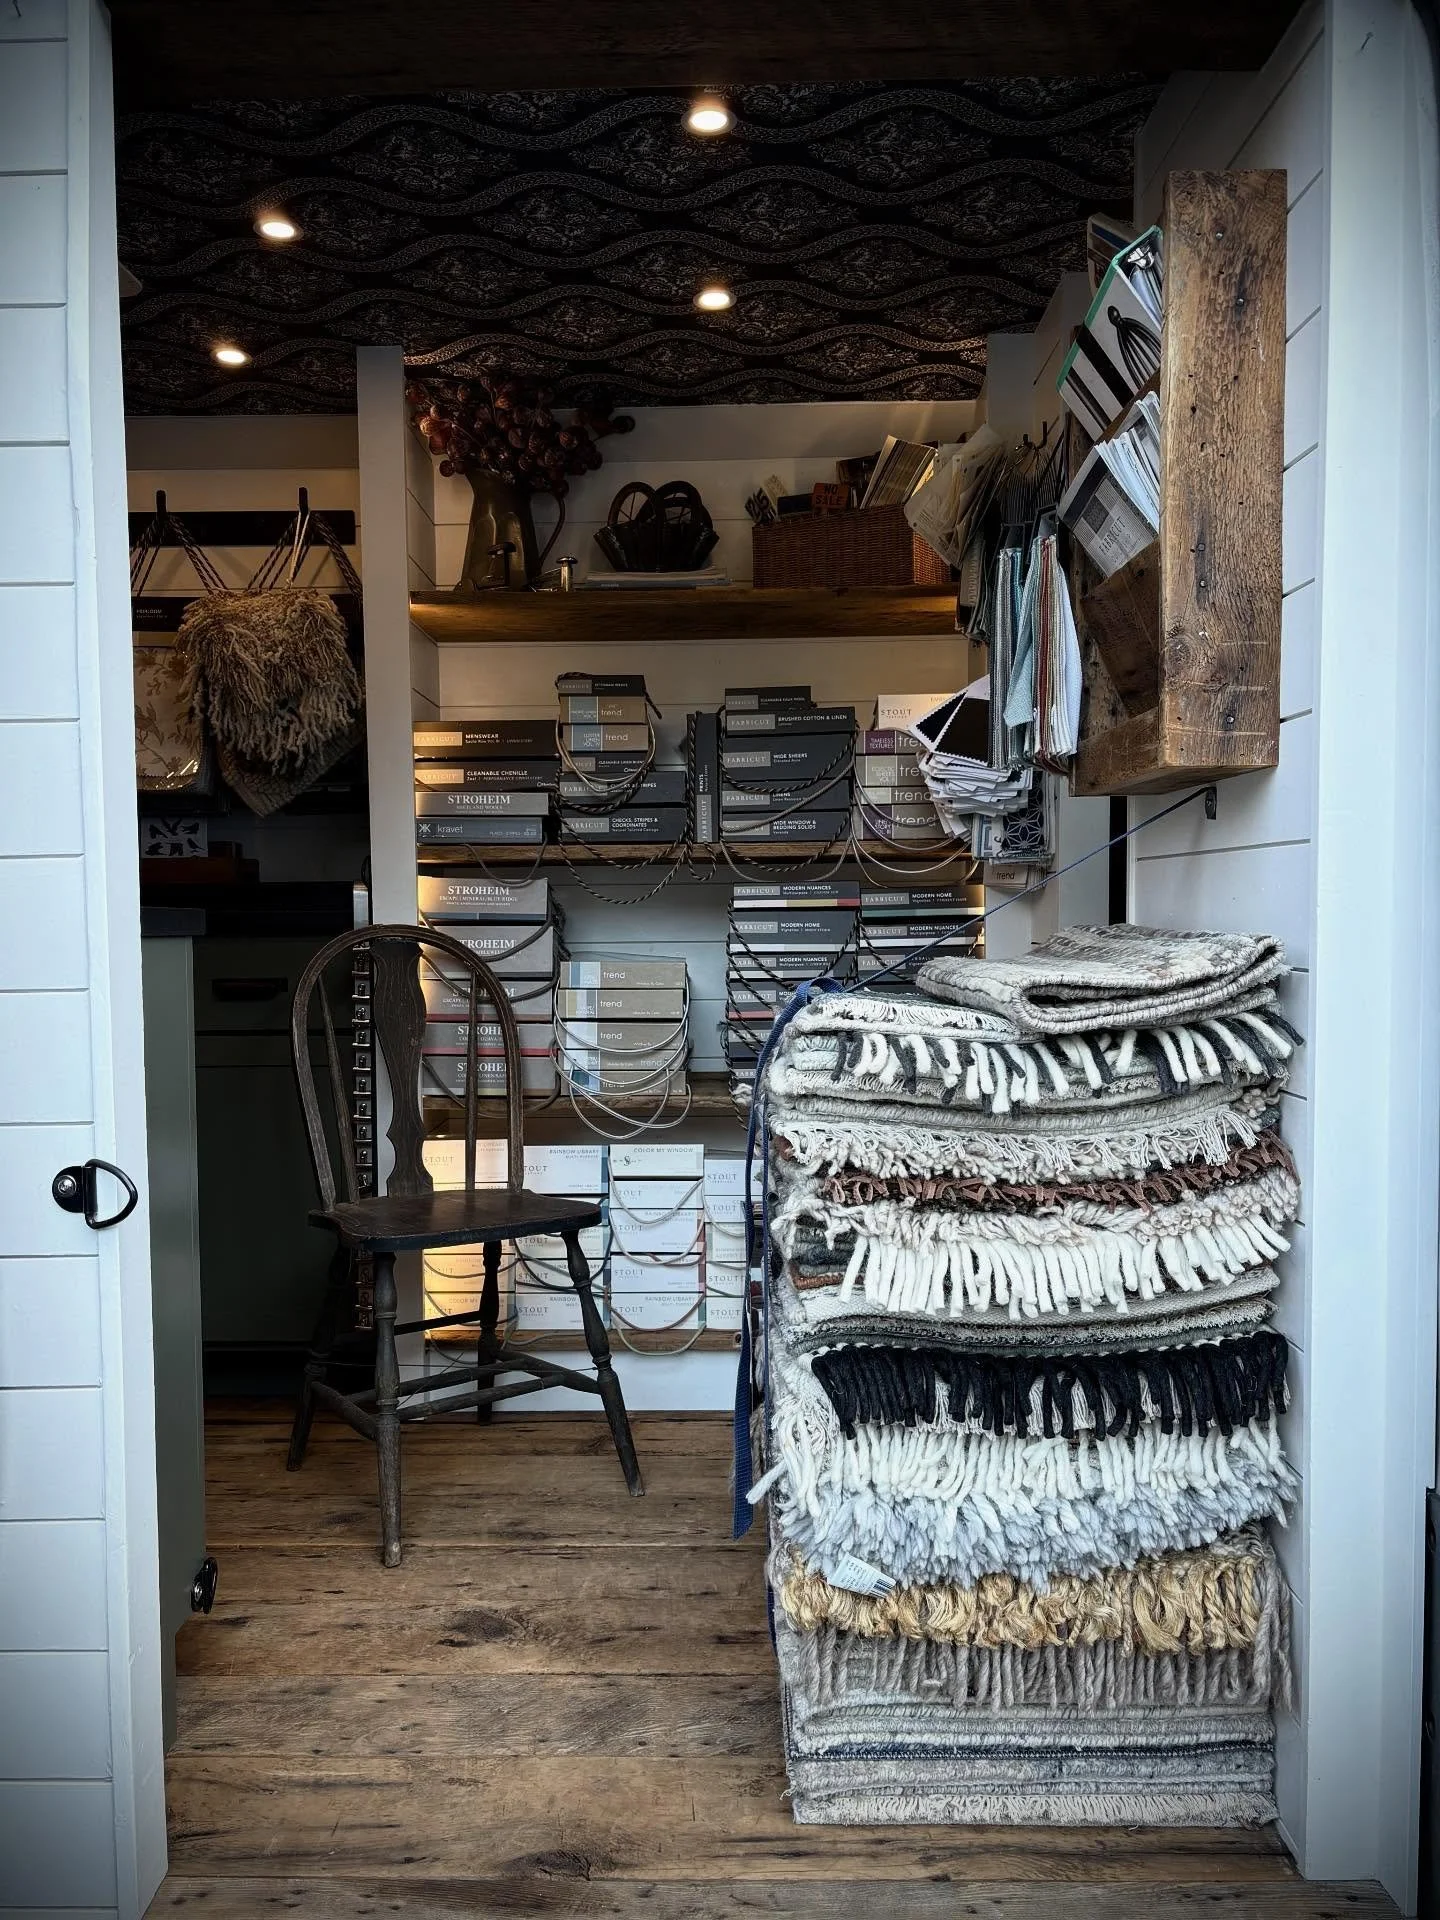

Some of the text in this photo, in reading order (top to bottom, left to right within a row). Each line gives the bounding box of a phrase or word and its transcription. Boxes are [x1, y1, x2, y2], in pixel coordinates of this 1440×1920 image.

[823, 484, 838, 493] NO
[815, 495, 844, 505] SALE
[1098, 517, 1127, 557] FABRICUT
[601, 709, 623, 717] trend
[880, 708, 912, 716] STOUT
[605, 734, 629, 742] trend
[727, 756, 766, 764] FABRICUT
[447, 794, 511, 805] STROHEIM
[895, 814, 937, 828] trend
[437, 823, 463, 833] kravet
[996, 871, 1015, 880] trend
[447, 885, 510, 896] STROHEIM
[459, 939, 515, 949] TROHEIM
[602, 971, 626, 979] trend
[599, 1000, 623, 1008] trend
[600, 1032, 623, 1040] trend
[640, 1058, 663, 1067] trend
[424, 1156, 455, 1164] STOUT
[707, 1173, 737, 1181] STOUT
